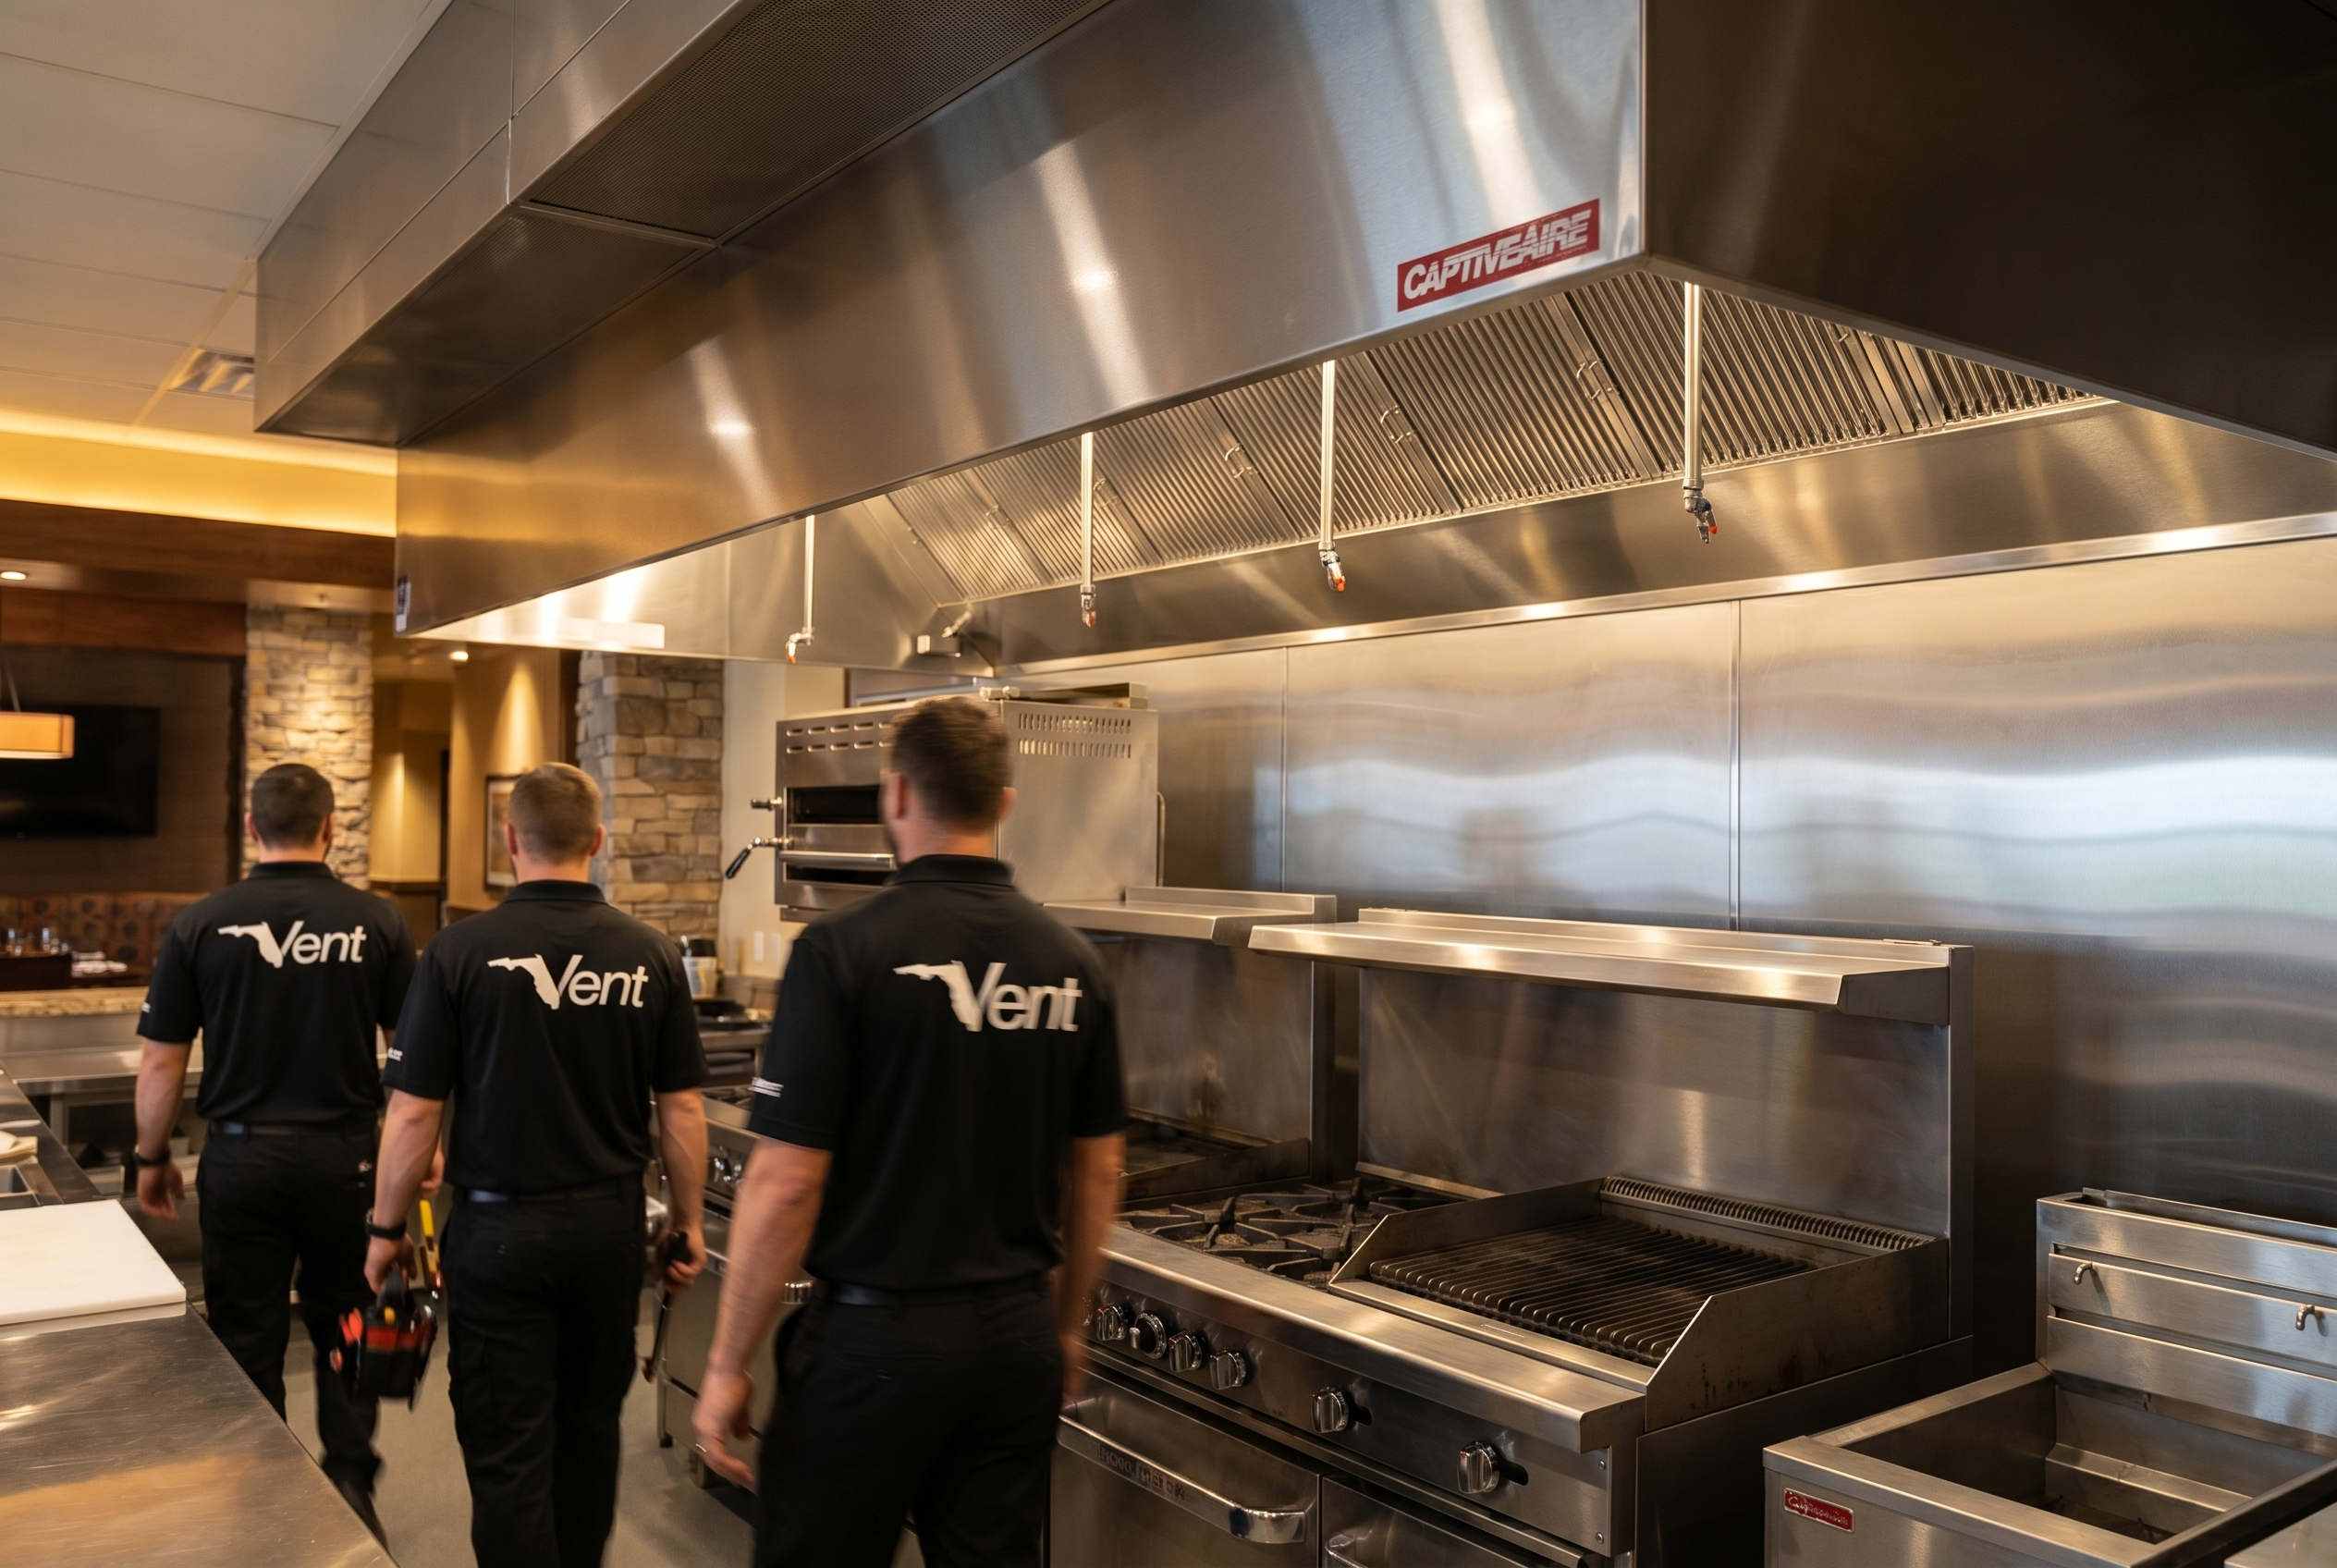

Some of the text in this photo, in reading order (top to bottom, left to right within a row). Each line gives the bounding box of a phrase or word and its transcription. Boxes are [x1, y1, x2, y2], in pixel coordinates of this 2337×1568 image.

[1403, 208, 1592, 300] CAPTIVEAIRE
[258, 920, 367, 969] Vent
[533, 953, 649, 1010] Vent
[948, 960, 1083, 1032] Vent
